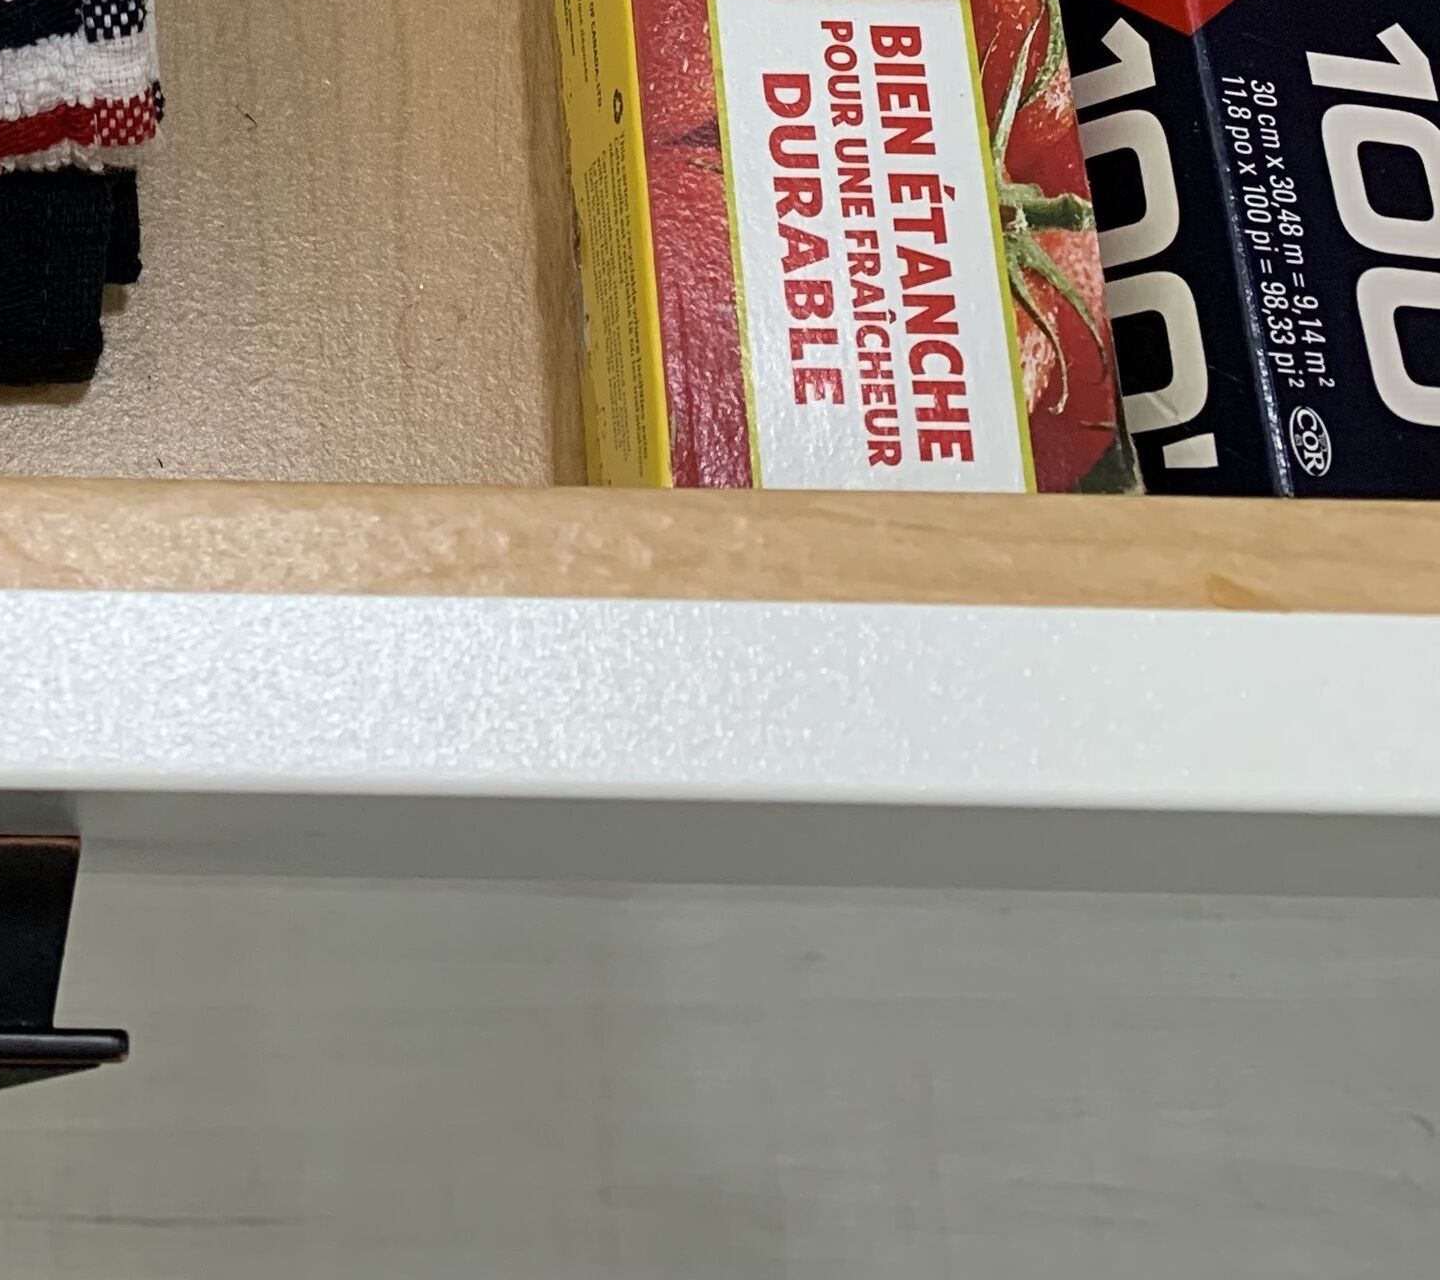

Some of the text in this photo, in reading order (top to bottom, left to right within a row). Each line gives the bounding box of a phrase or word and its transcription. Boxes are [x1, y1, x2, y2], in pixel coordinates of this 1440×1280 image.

[1220, 74, 1252, 124] 11,8
[1250, 78, 1276, 109] 30
[1224, 126, 1254, 158] po
[1255, 110, 1281, 149] cm
[1238, 159, 1258, 177] x
[1265, 153, 1285, 170] x
[1241, 182, 1273, 224] 100
[1267, 172, 1305, 240] 30,48
[761, 72, 847, 407] DURABLE
[820, 20, 904, 469] POUR UNE FRAÎCHEUR
[869, 25, 977, 464] BIEN ÉTANCHE
[1245, 229, 1273, 253] pi
[1284, 243, 1305, 264] m
[1259, 280, 1296, 346] 98,33
[1291, 294, 1326, 346] 9,14
